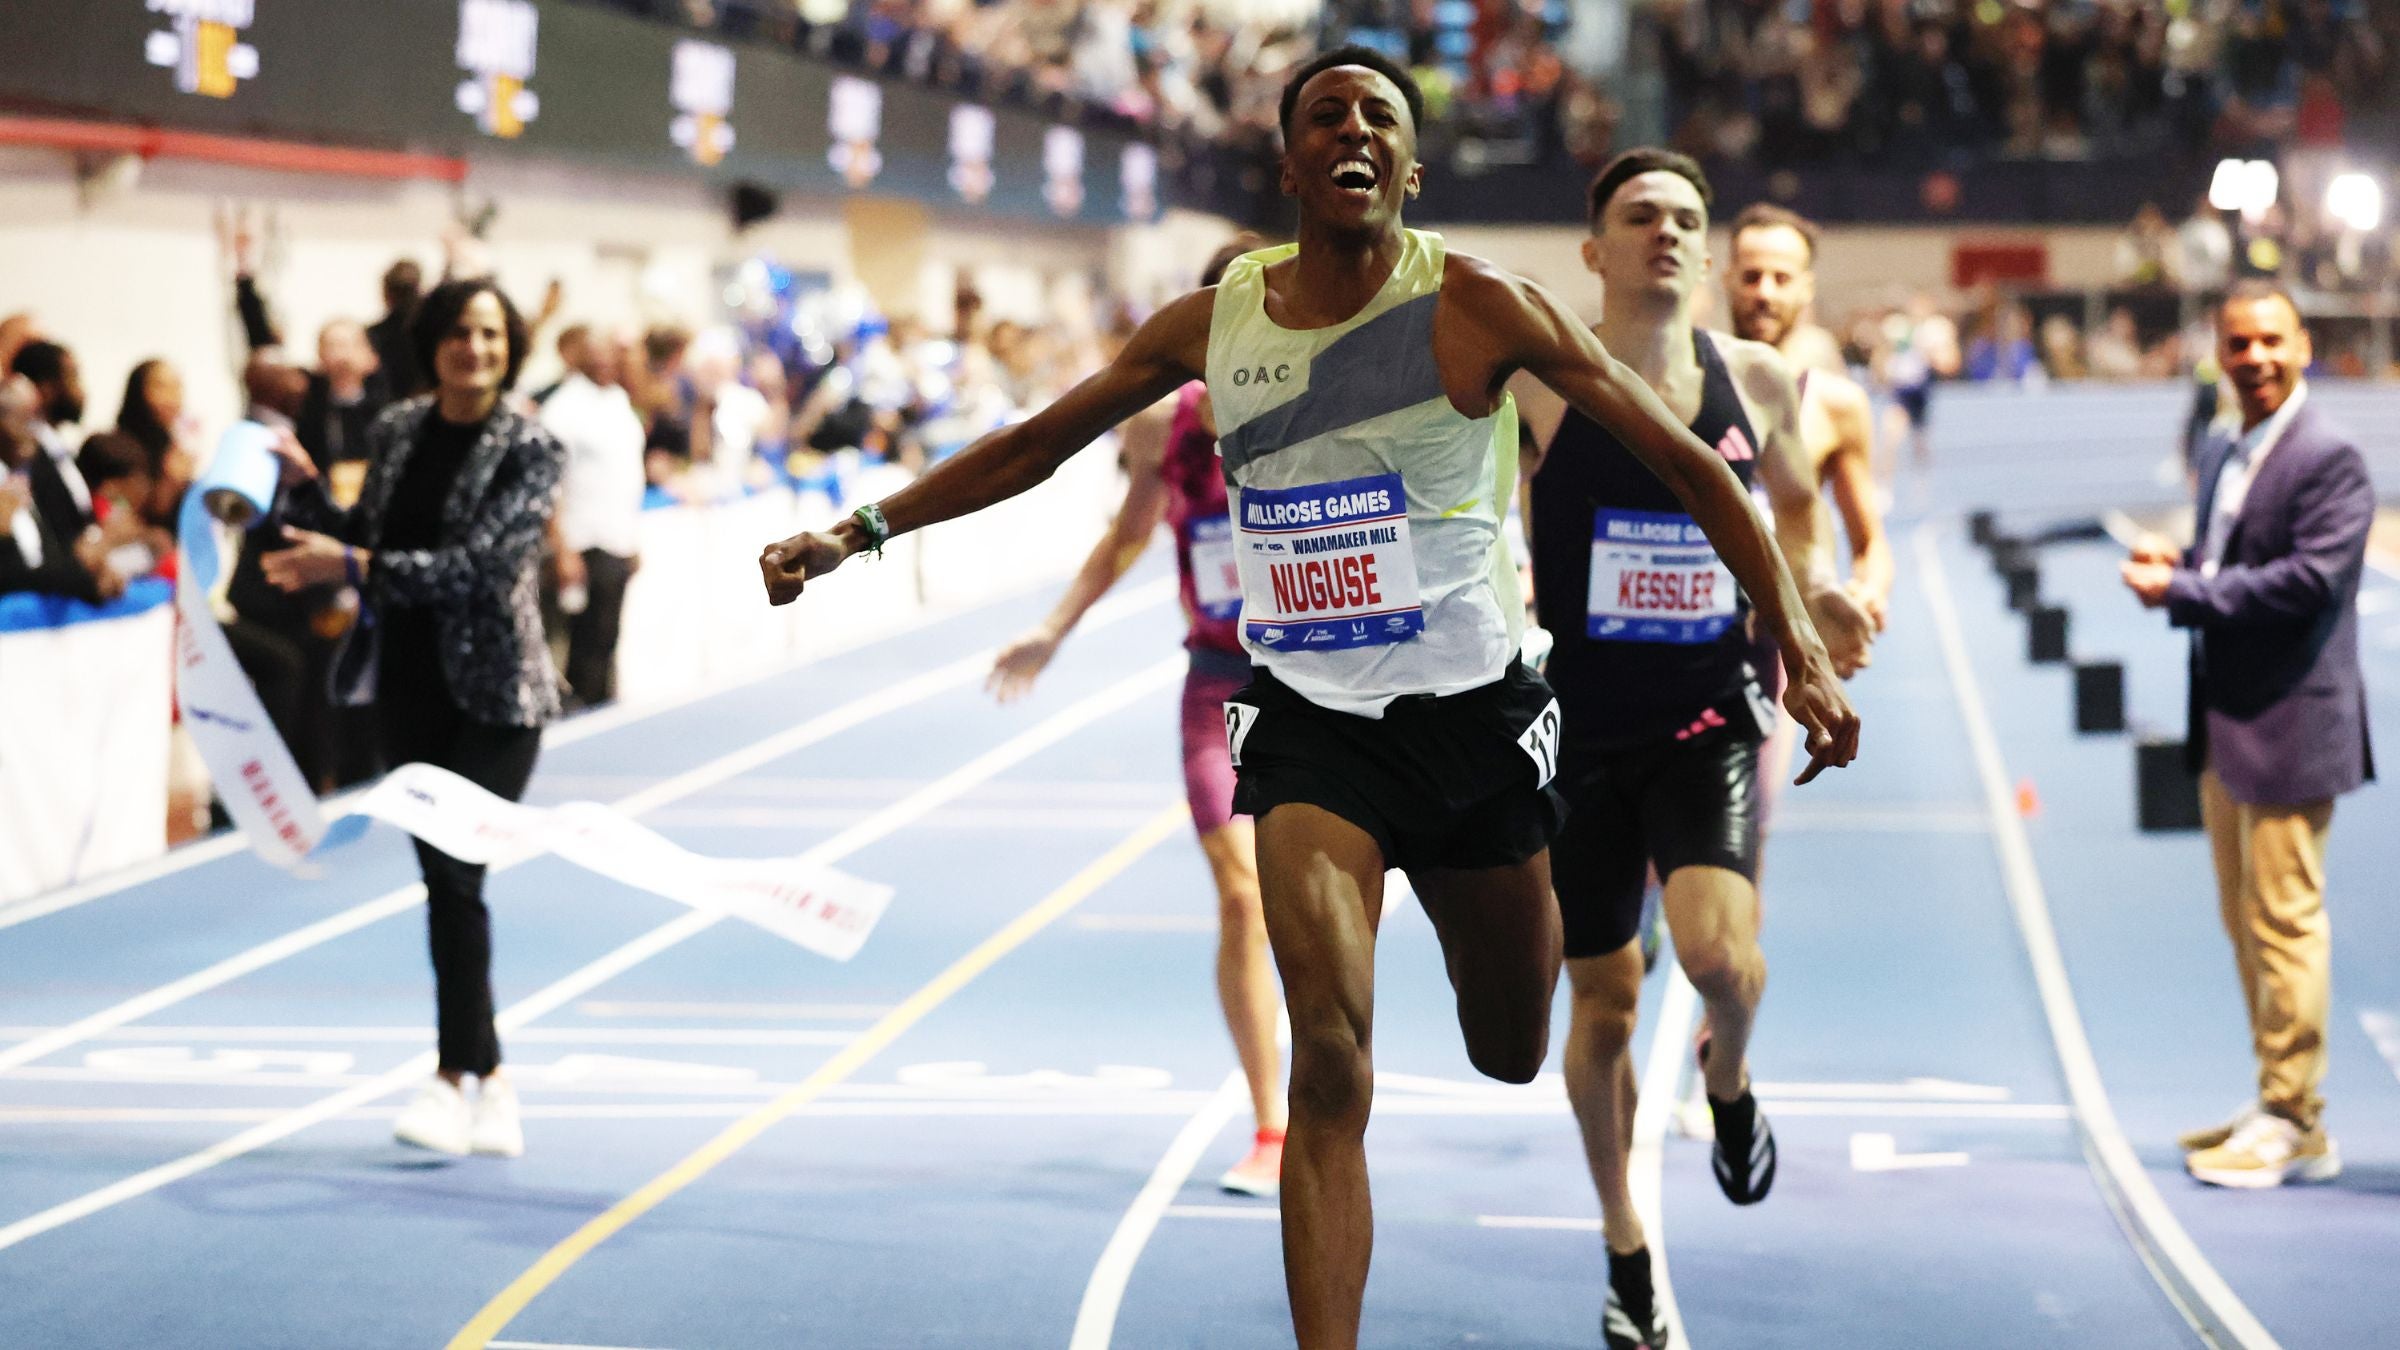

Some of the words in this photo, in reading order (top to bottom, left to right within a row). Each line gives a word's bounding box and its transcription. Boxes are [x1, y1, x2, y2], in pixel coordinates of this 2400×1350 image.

[1233, 364, 1290, 386] OAC
[1247, 499, 1322, 526] MILLROSE
[1325, 489, 1391, 519] GAMES
[1292, 531, 1366, 554] WANAMAKER
[1369, 526, 1398, 547] MILE
[1269, 553, 1382, 614] NUGUSE
[1618, 570, 1716, 611] KESSLER
